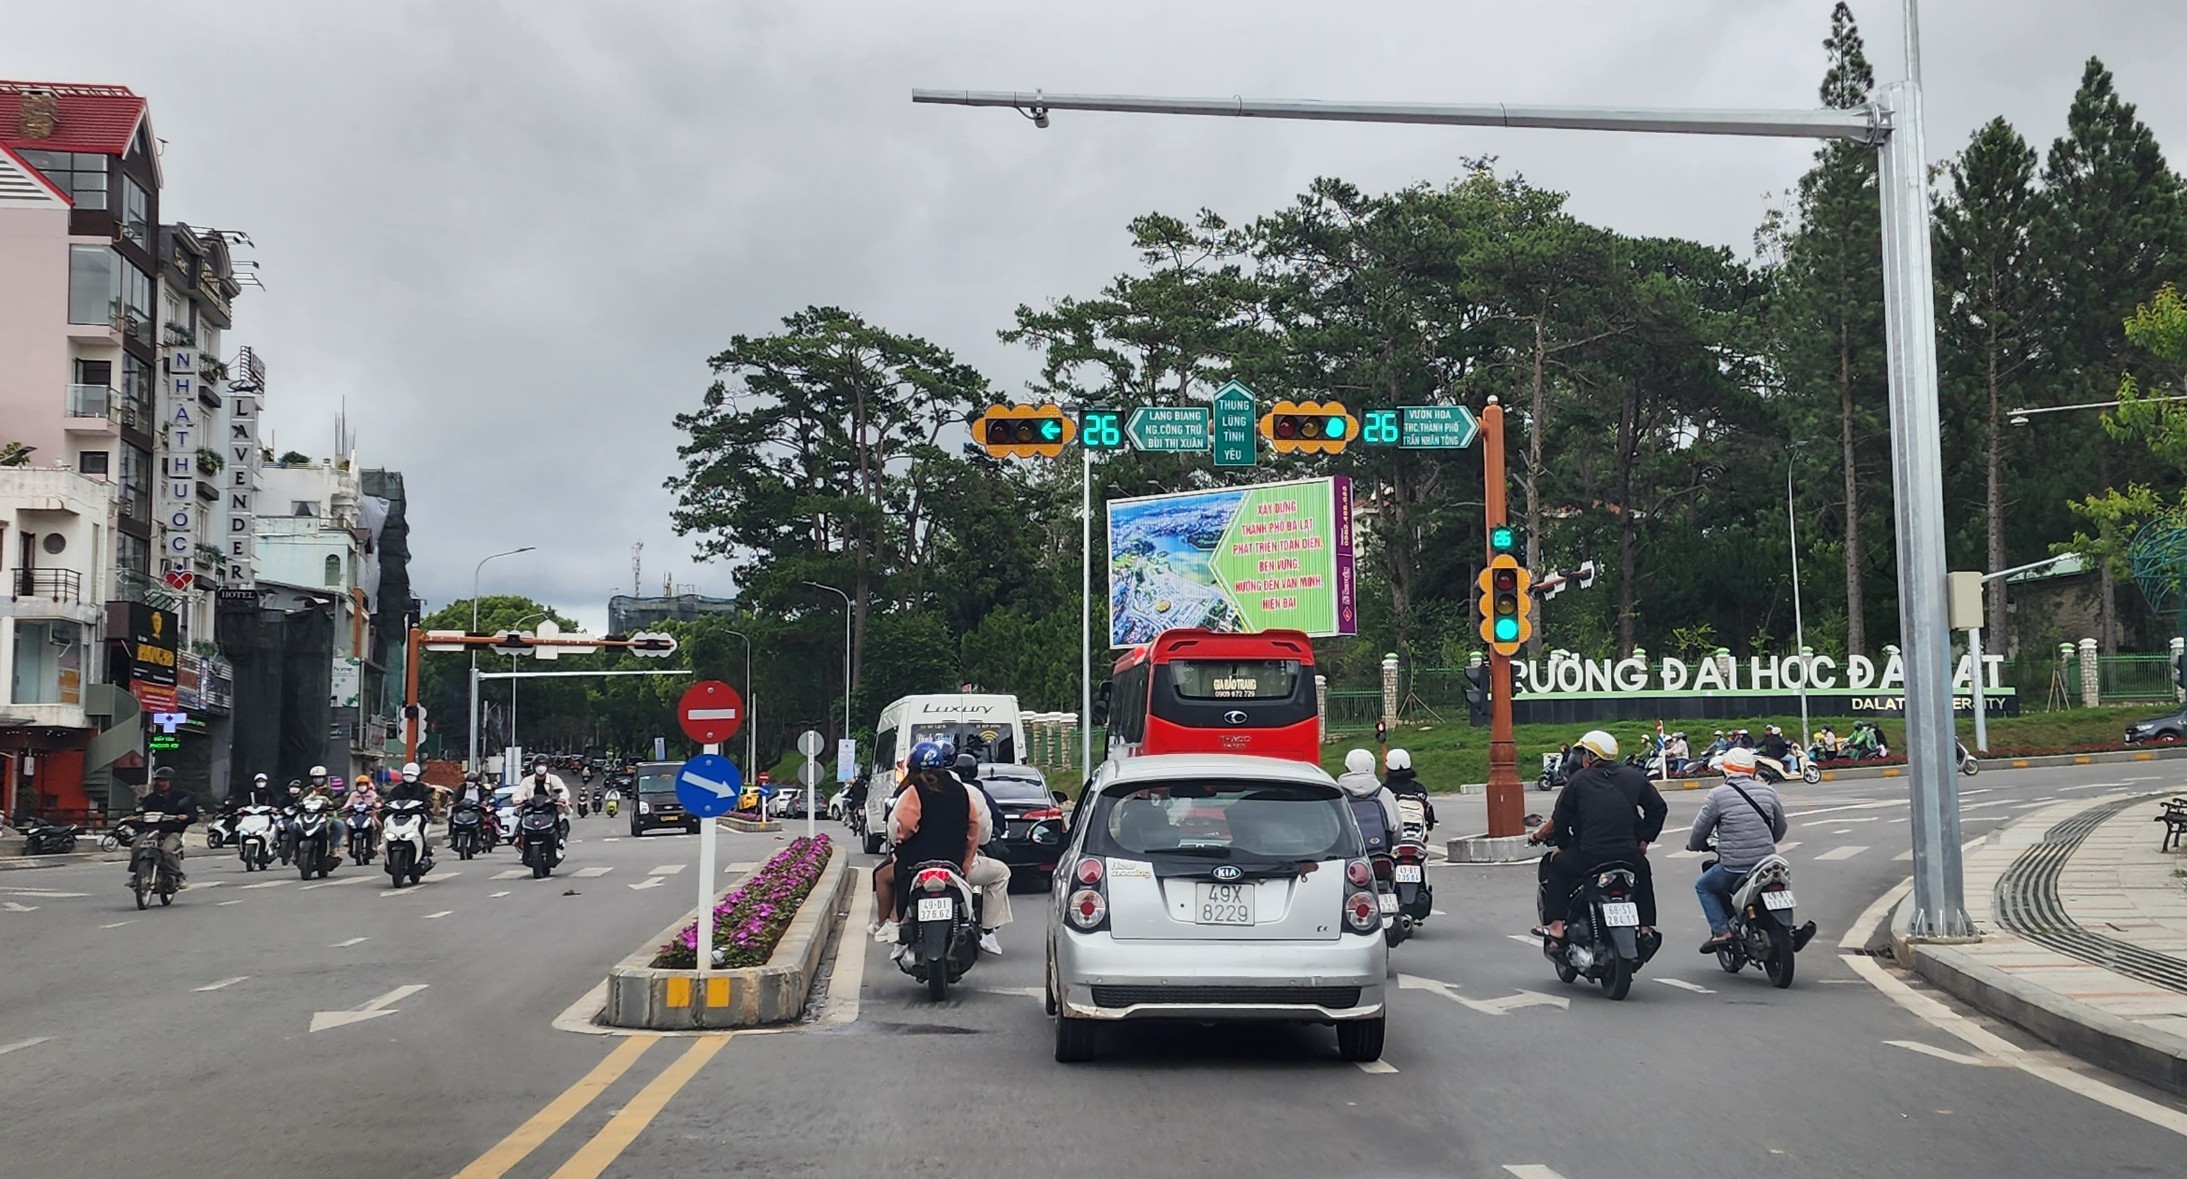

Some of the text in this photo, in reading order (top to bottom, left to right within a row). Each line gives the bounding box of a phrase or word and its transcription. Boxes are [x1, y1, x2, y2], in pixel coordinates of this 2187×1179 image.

[1219, 400, 1250, 411] THUNG
[1149, 411, 1201, 421] LANG BIANG
[1434, 410, 1451, 419] HOA
[1222, 415, 1247, 427] LŨNG
[1083, 414, 1119, 446] 26
[1363, 413, 1399, 442] 26
[1223, 430, 1245, 442] TÌNH
[1224, 448, 1242, 460] YÊU
[231, 399, 249, 580] LAVENDER
[221, 590, 256, 599] HOTEL
[1660, 656, 1738, 695] ĐẠI
[1237, 678, 1257, 690] TRANG
[922, 703, 994, 714] Luxury
[1852, 697, 1906, 711] DALAT
[1218, 868, 1237, 877] KIA
[1208, 885, 1242, 903] 49X
[1202, 904, 1248, 922] 8229
